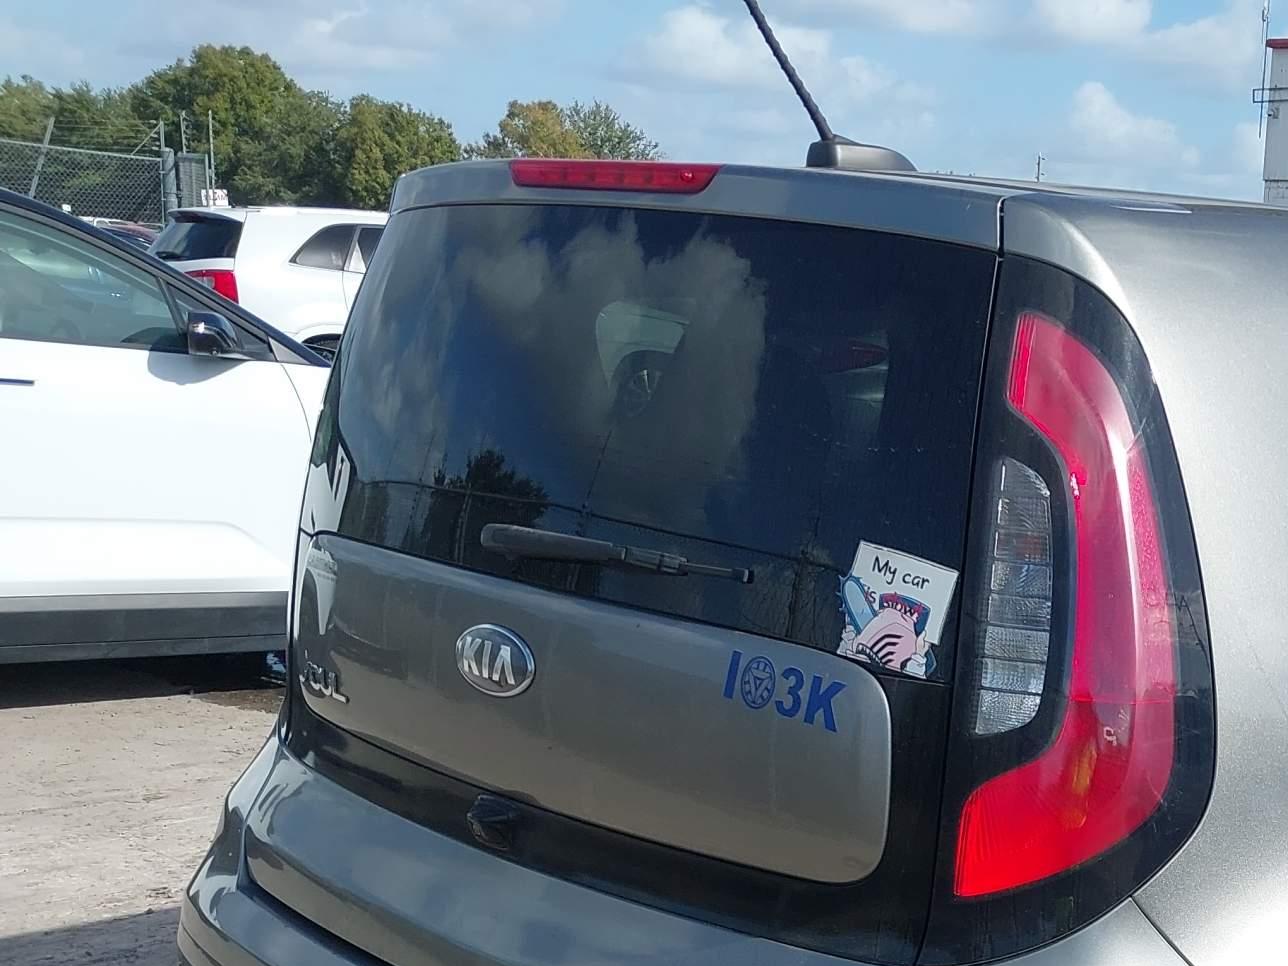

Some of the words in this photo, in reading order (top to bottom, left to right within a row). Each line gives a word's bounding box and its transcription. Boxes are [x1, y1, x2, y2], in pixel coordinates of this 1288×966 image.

[872, 556, 897, 585] My
[902, 573, 930, 589] car
[463, 635, 516, 685] KIA
